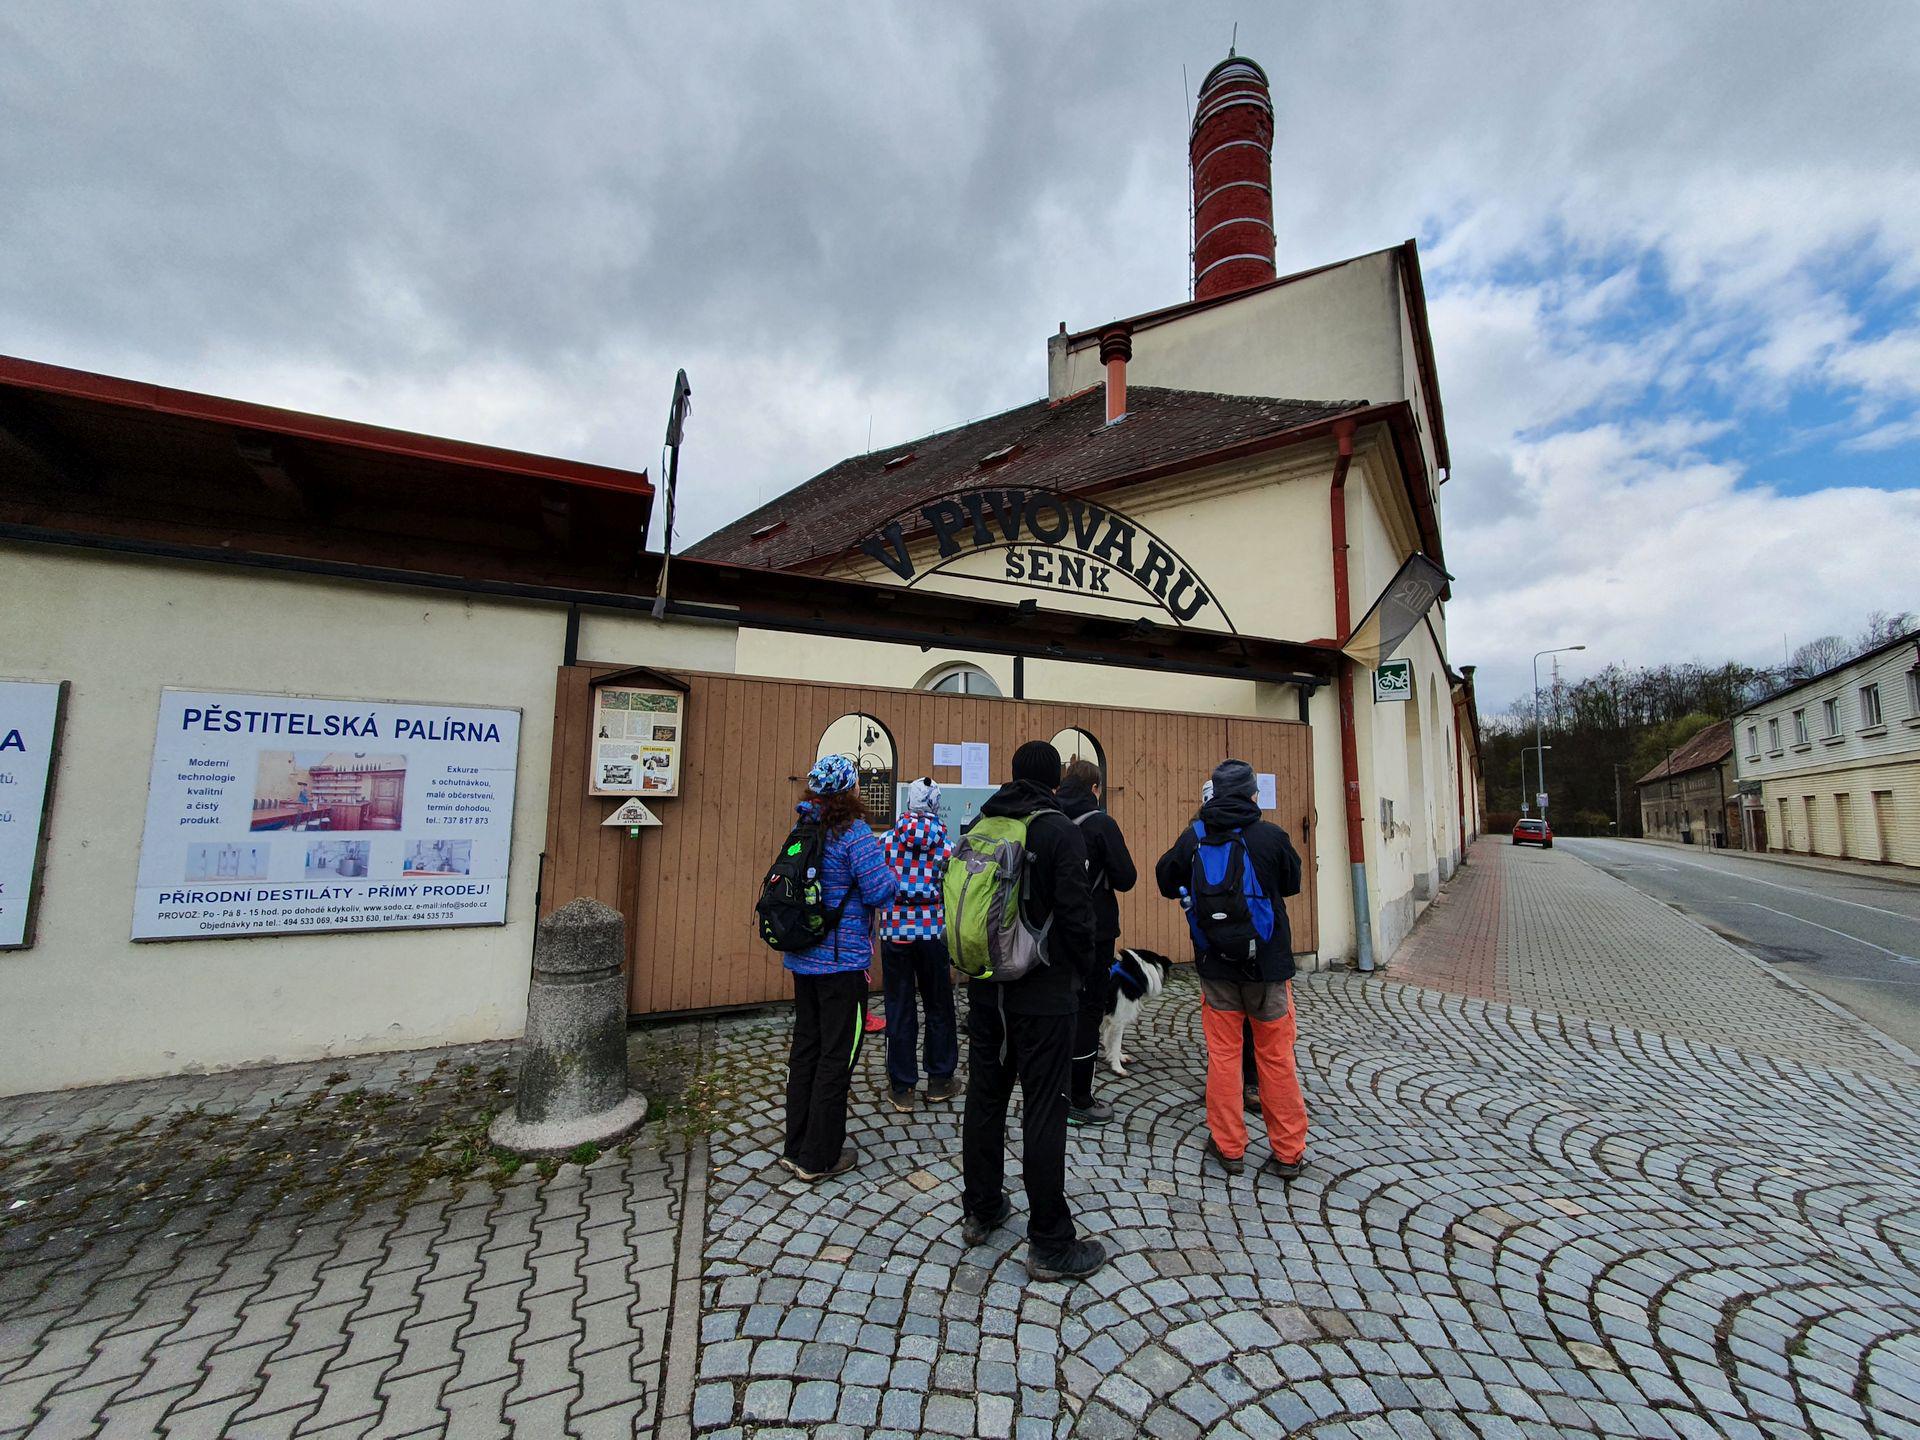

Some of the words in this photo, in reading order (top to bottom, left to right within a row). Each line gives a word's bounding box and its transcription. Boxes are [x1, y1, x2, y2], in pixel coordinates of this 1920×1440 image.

[861, 521, 916, 582] V
[921, 491, 1210, 622] PIVOVARU
[1005, 547, 1110, 593] ŠENK
[182, 704, 379, 738] PĚSTITELSKÁ
[394, 716, 500, 743] PALÍRNA
[188, 758, 230, 768] Moderní
[447, 765, 479, 774] Exkurze
[177, 773, 236, 784] technologie
[438, 779, 491, 788] ochutnávkou,
[187, 787, 224, 796] kvalitní
[447, 792, 495, 801] občerstvení,
[195, 801, 219, 811] čistý
[427, 804, 453, 812] termín
[455, 804, 492, 813] dohodou,
[180, 816, 221, 826] produkt.
[474, 817, 489, 825] 873
[159, 888, 252, 904] PŘÍRODNÍ
[257, 886, 353, 901] DESTILÁTY
[368, 884, 418, 898] PŘÍMÝ
[423, 884, 490, 897] PRODEJ!
[158, 912, 200, 920] PROVOZ:
[223, 909, 233, 917] Pá
[261, 908, 279, 916] hod.
[282, 908, 292, 916] po
[327, 904, 361, 914] kdykoliv,
[200, 919, 250, 930] Objednávky
[427, 912, 440, 920] 535
[441, 911, 454, 919] 735
